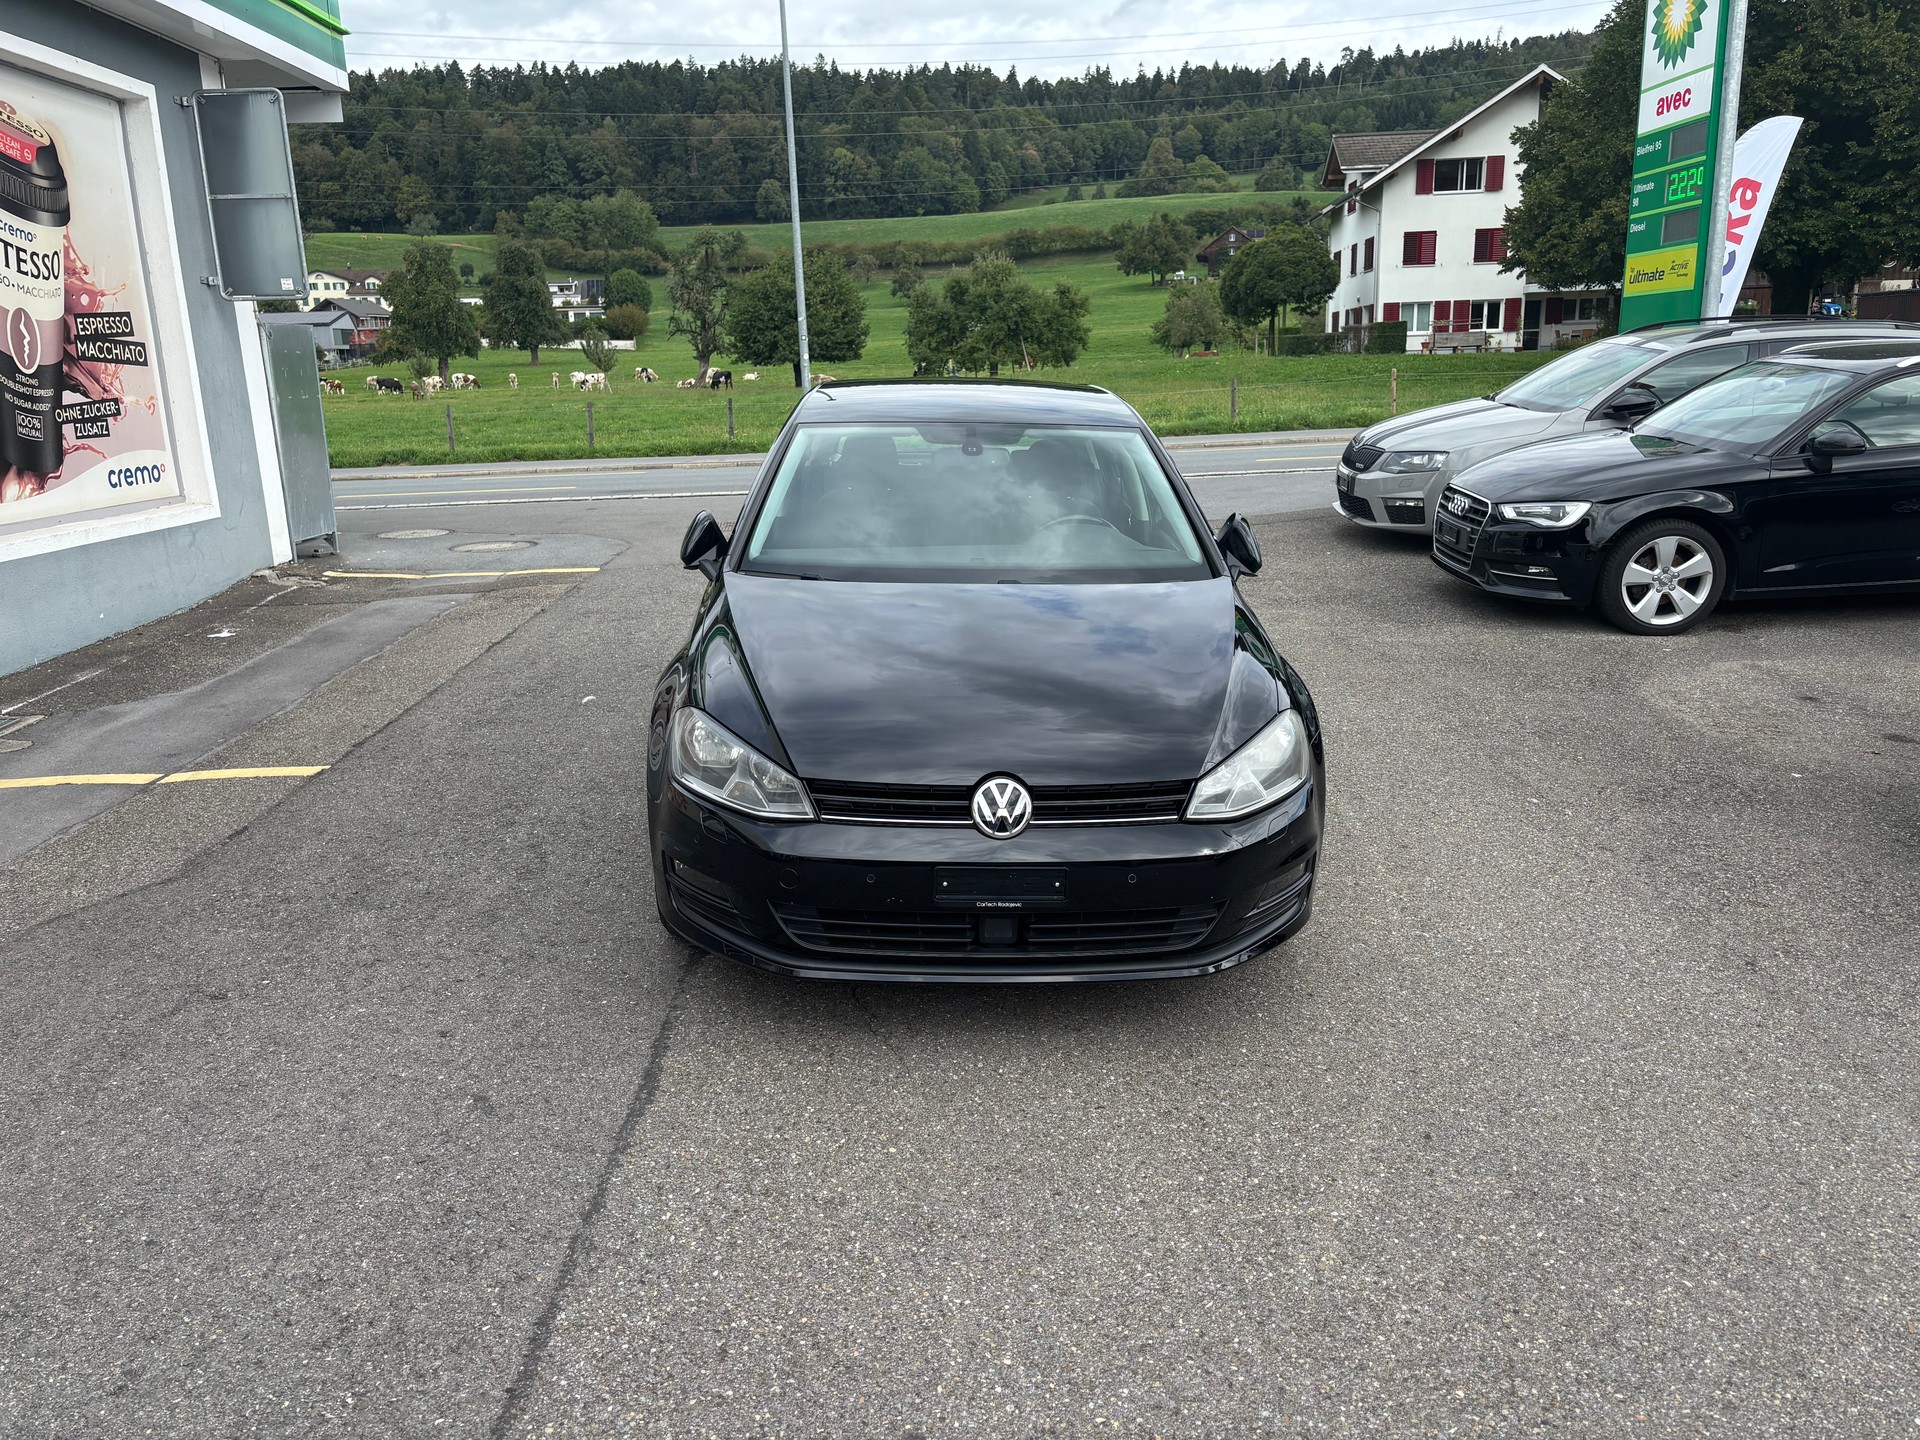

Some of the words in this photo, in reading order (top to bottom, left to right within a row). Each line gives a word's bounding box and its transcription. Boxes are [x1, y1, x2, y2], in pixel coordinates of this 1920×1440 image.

[1656, 88, 1691, 116] avec
[5, 145, 22, 160] SAFE
[1655, 140, 1662, 151] 95
[1634, 182, 1655, 194] Ultimate
[1632, 197, 1639, 207] 98
[1630, 221, 1646, 233] Diesel
[1629, 267, 1665, 285] ultimate
[17, 282, 61, 298] MACCHIATO
[76, 316, 131, 336] ESPRESSO
[76, 340, 145, 362] MACCHIATO
[15, 373, 39, 387] STRONG
[4, 391, 14, 402] NO
[14, 396, 32, 410] SUGAR
[55, 407, 82, 422] OHNE
[82, 401, 119, 417] ZUCKER-
[17, 414, 41, 429] 100%
[75, 422, 108, 436] ZUSATZ
[18, 425, 42, 438] NATURAL
[108, 464, 161, 489] cremo
